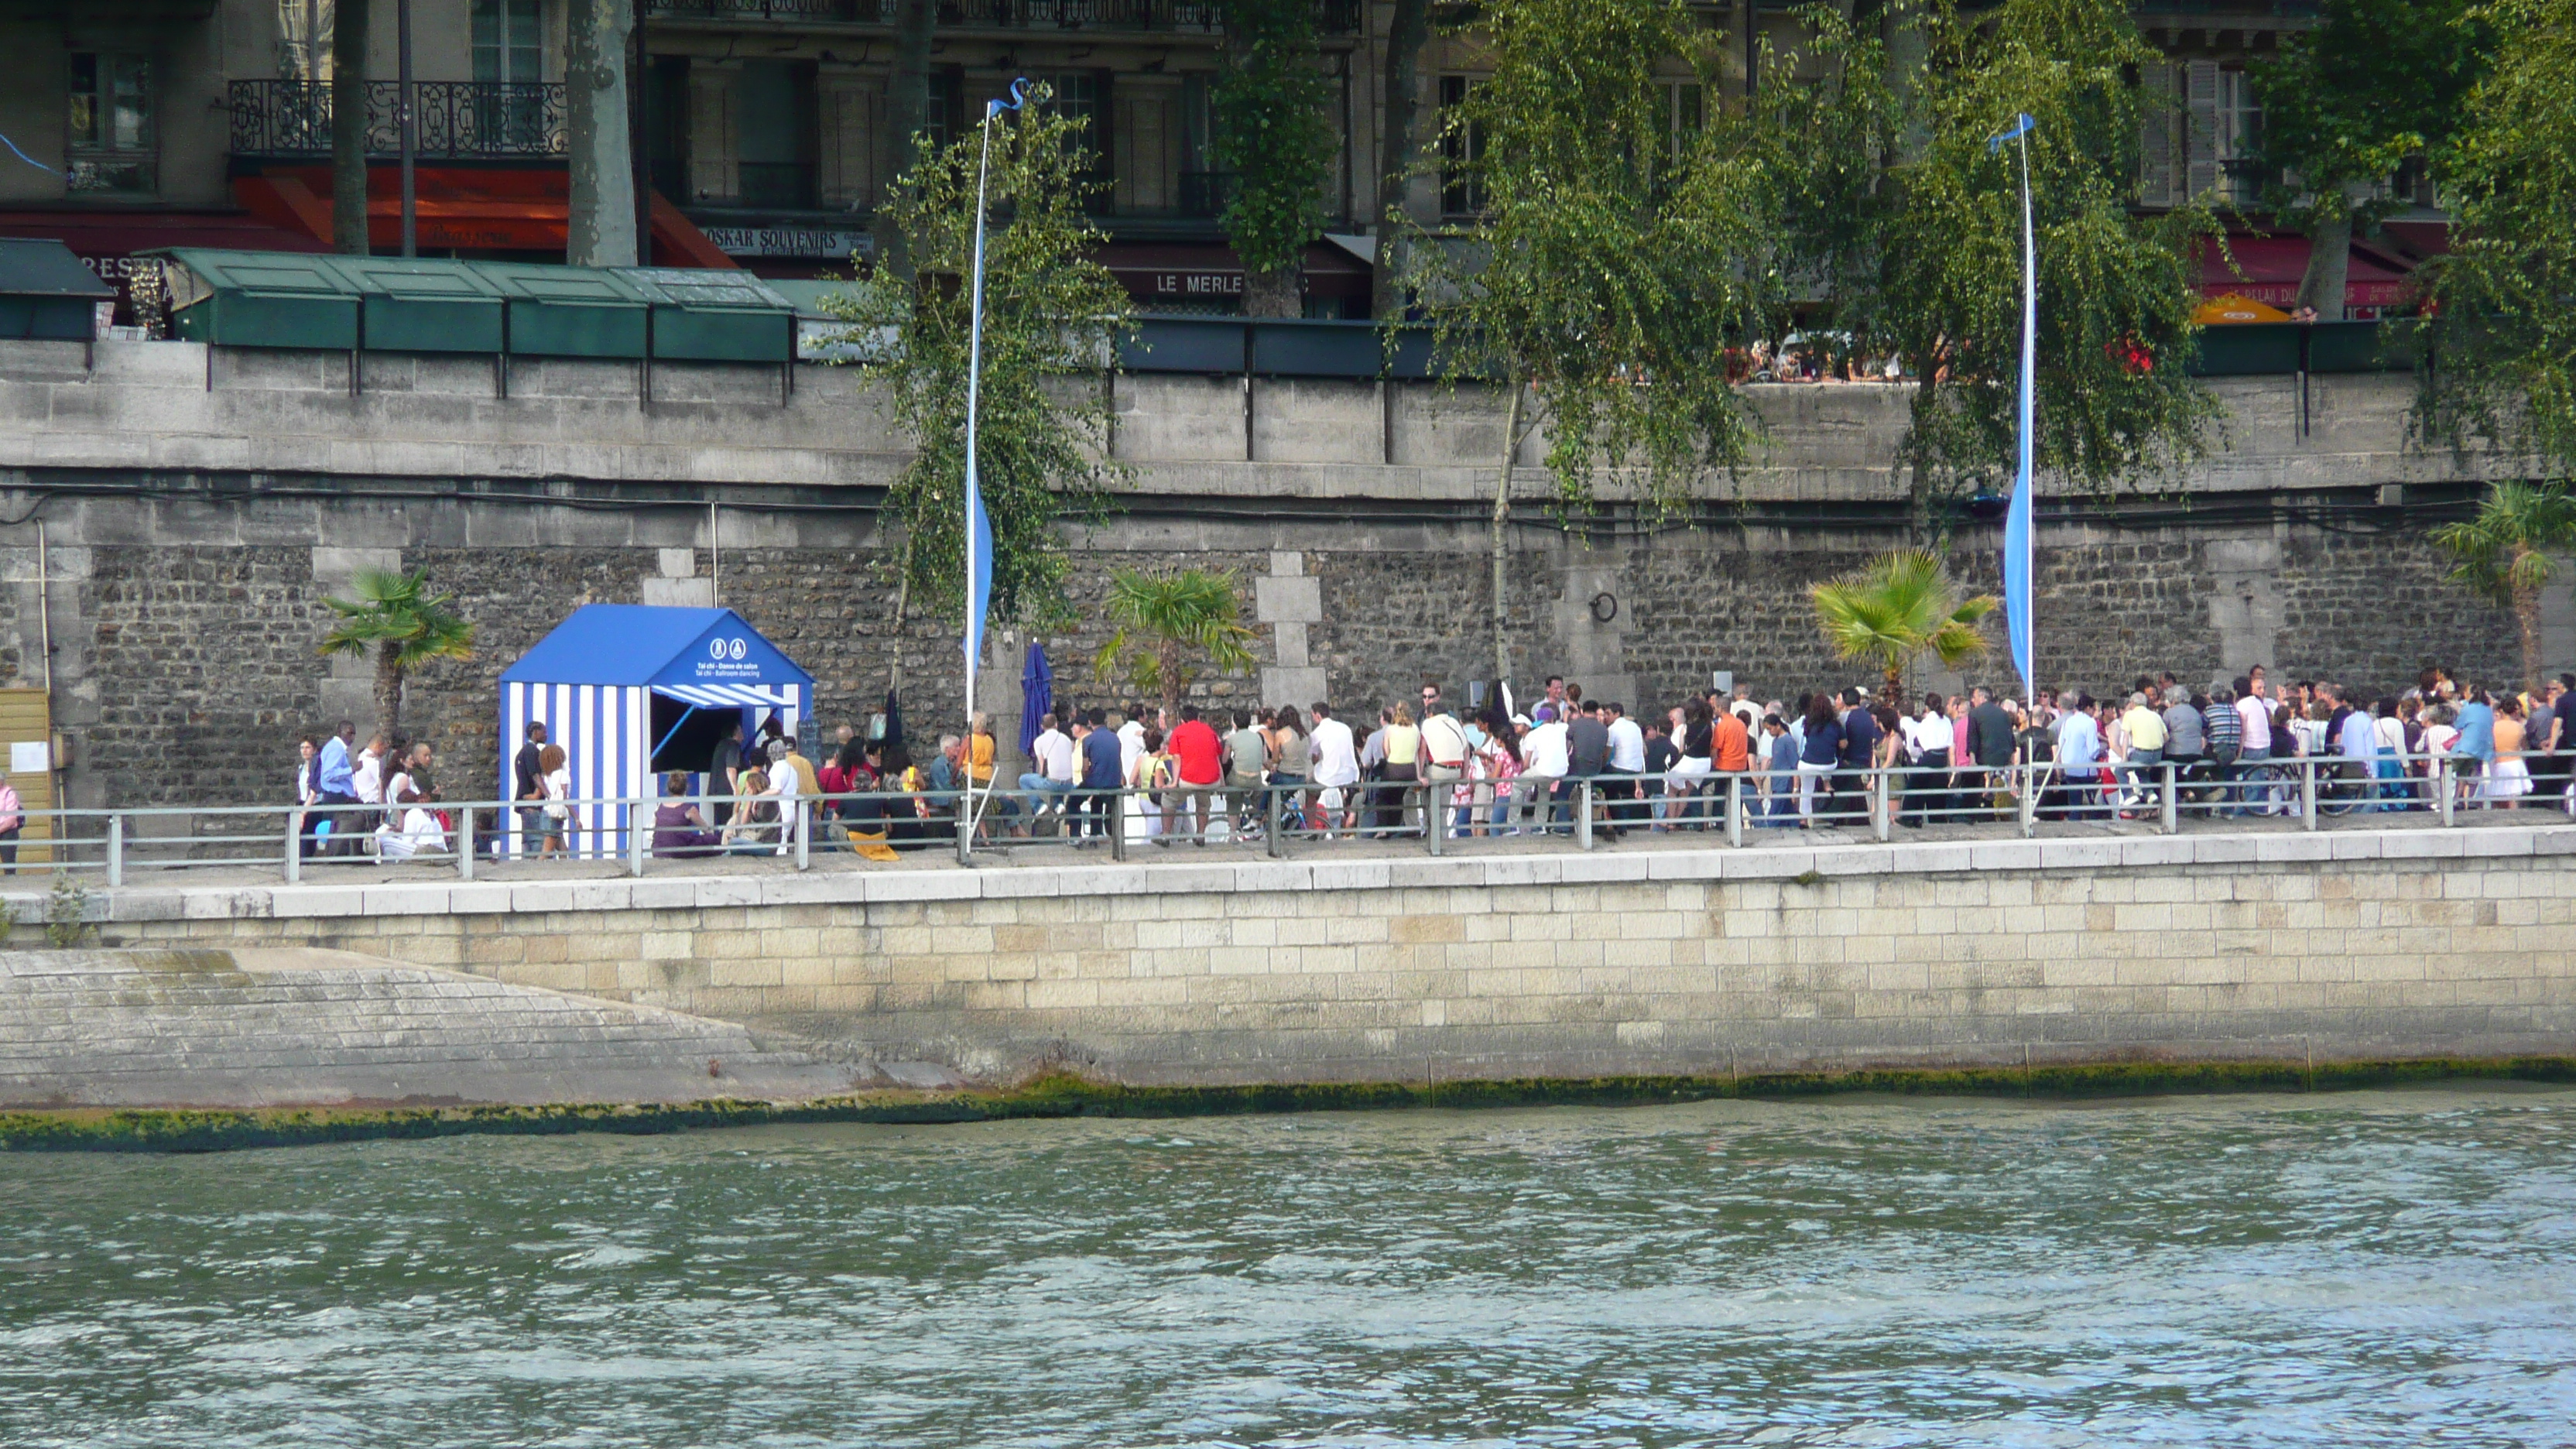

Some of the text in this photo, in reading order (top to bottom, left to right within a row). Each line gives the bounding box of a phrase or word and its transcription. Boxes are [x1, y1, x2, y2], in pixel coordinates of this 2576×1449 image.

[707, 229, 837, 248] OSKAR SOUVENIRS
[1157, 275, 1242, 293] LE MERLE
[2281, 288, 2295, 303] DU
[739, 670, 760, 678] dancing
